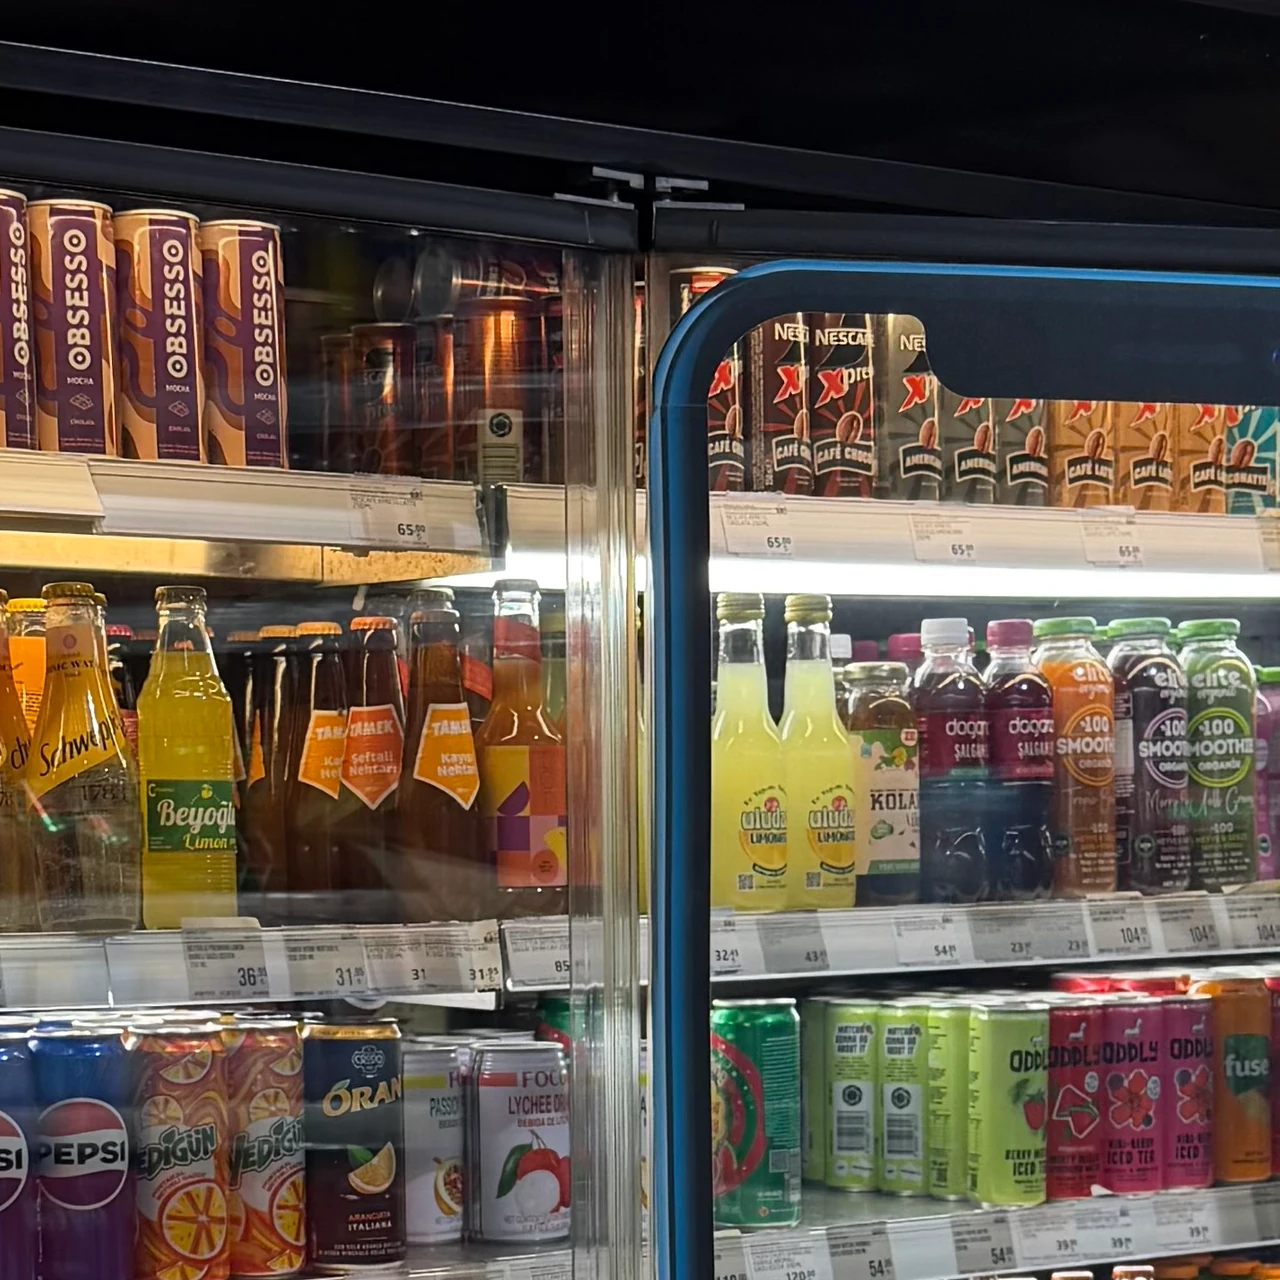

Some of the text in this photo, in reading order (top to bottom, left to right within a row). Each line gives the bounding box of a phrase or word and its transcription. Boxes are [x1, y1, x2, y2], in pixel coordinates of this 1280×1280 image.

[8, 221, 31, 366] OBSESSO
[63, 228, 92, 371] OBSESSO
[162, 239, 188, 379] OBSESSO
[252, 249, 275, 387] OBSESSO
[816, 328, 874, 348] NESCAF
[1057, 736, 1114, 754] SMOOTH
[741, 806, 787, 830] uluda
[808, 805, 855, 829] uluda
[183, 833, 228, 850] Limon
[1102, 1038, 1158, 1064] ODDLY
[1224, 1055, 1269, 1079] fuse
[508, 1095, 551, 1114] LYCHEE
[39, 1141, 125, 1164] PEPSI
